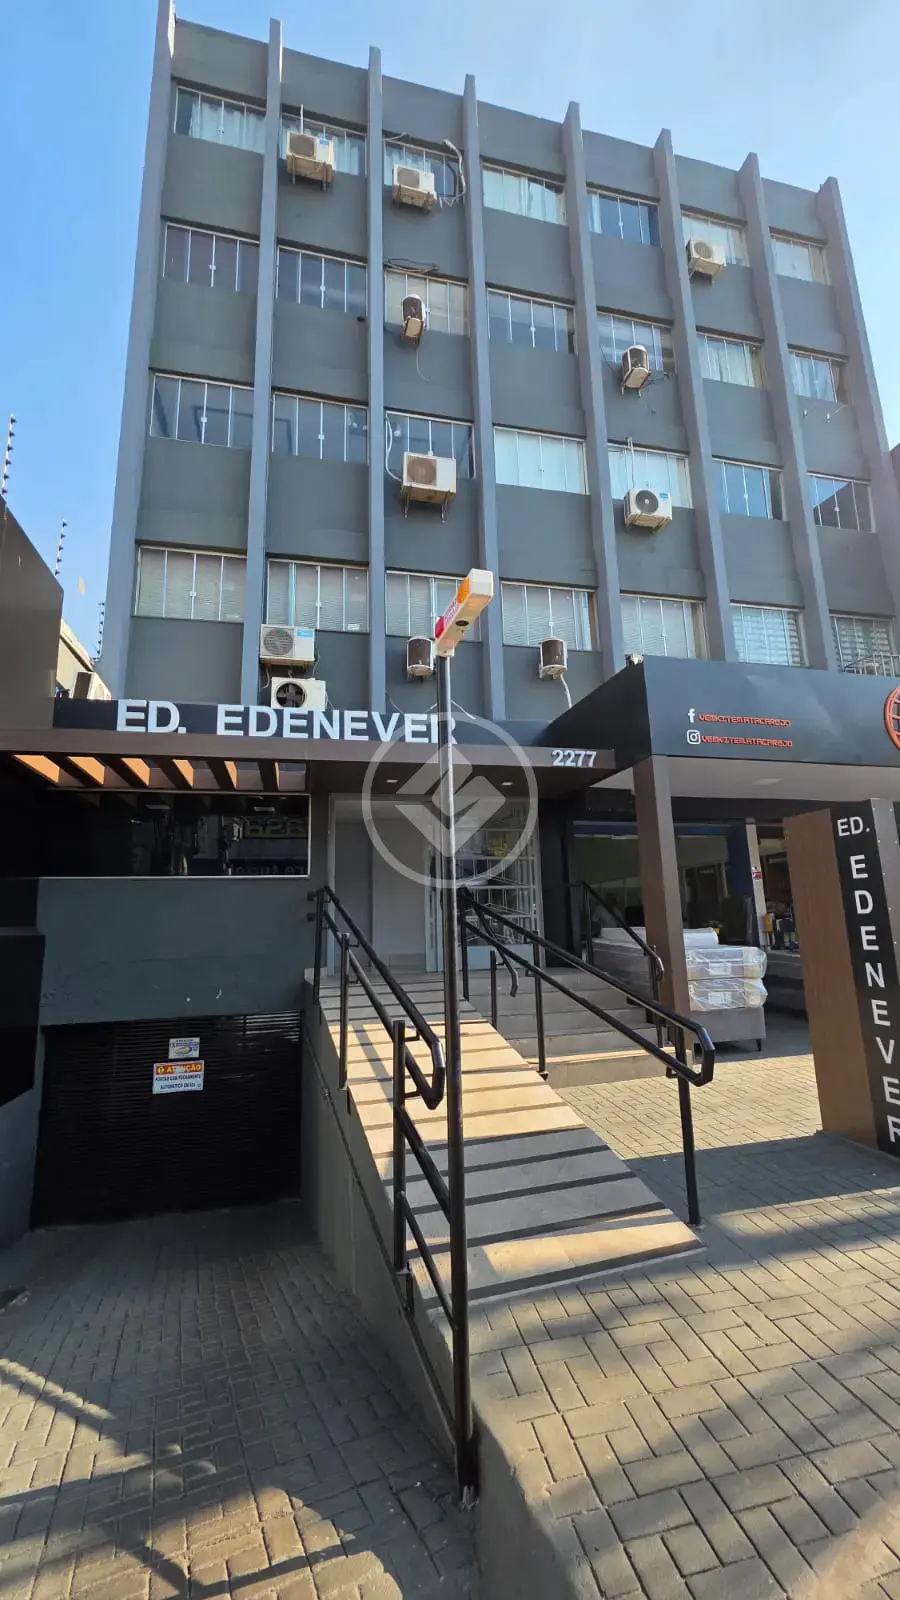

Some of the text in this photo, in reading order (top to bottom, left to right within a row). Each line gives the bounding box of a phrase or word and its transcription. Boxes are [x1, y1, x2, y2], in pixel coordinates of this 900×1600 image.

[116, 698, 458, 744] ED. EDENEVER
[551, 749, 597, 767] 2277
[837, 816, 870, 837] ED.
[850, 854, 900, 1143] EDENEVER
